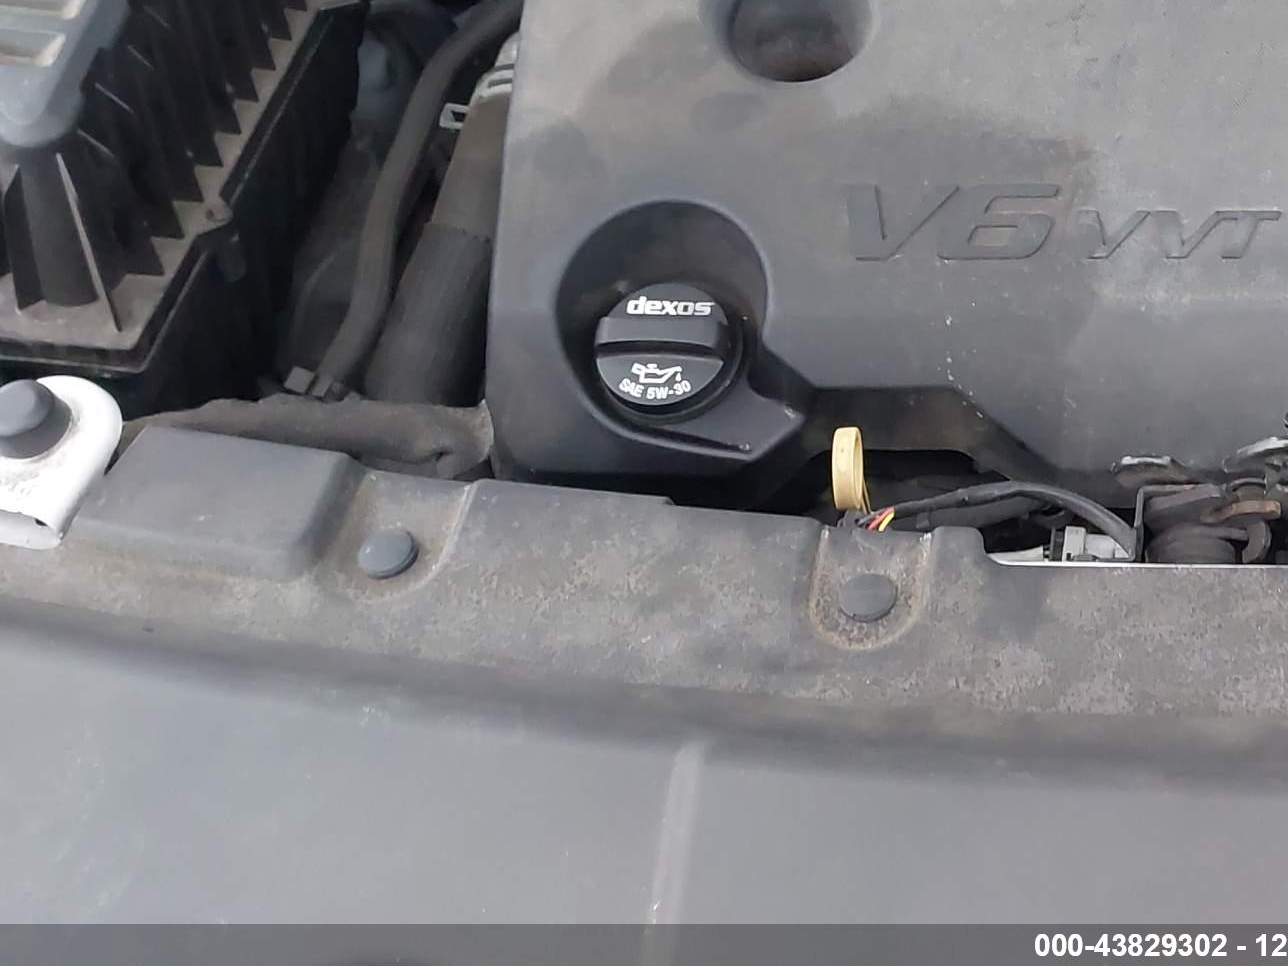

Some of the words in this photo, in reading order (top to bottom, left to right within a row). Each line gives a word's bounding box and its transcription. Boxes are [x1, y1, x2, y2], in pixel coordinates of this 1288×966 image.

[842, 183, 1060, 261] V6
[1075, 209, 1283, 260] VVT
[626, 295, 716, 316] dexos
[619, 378, 645, 398] SAE
[646, 380, 692, 400] 5W-30
